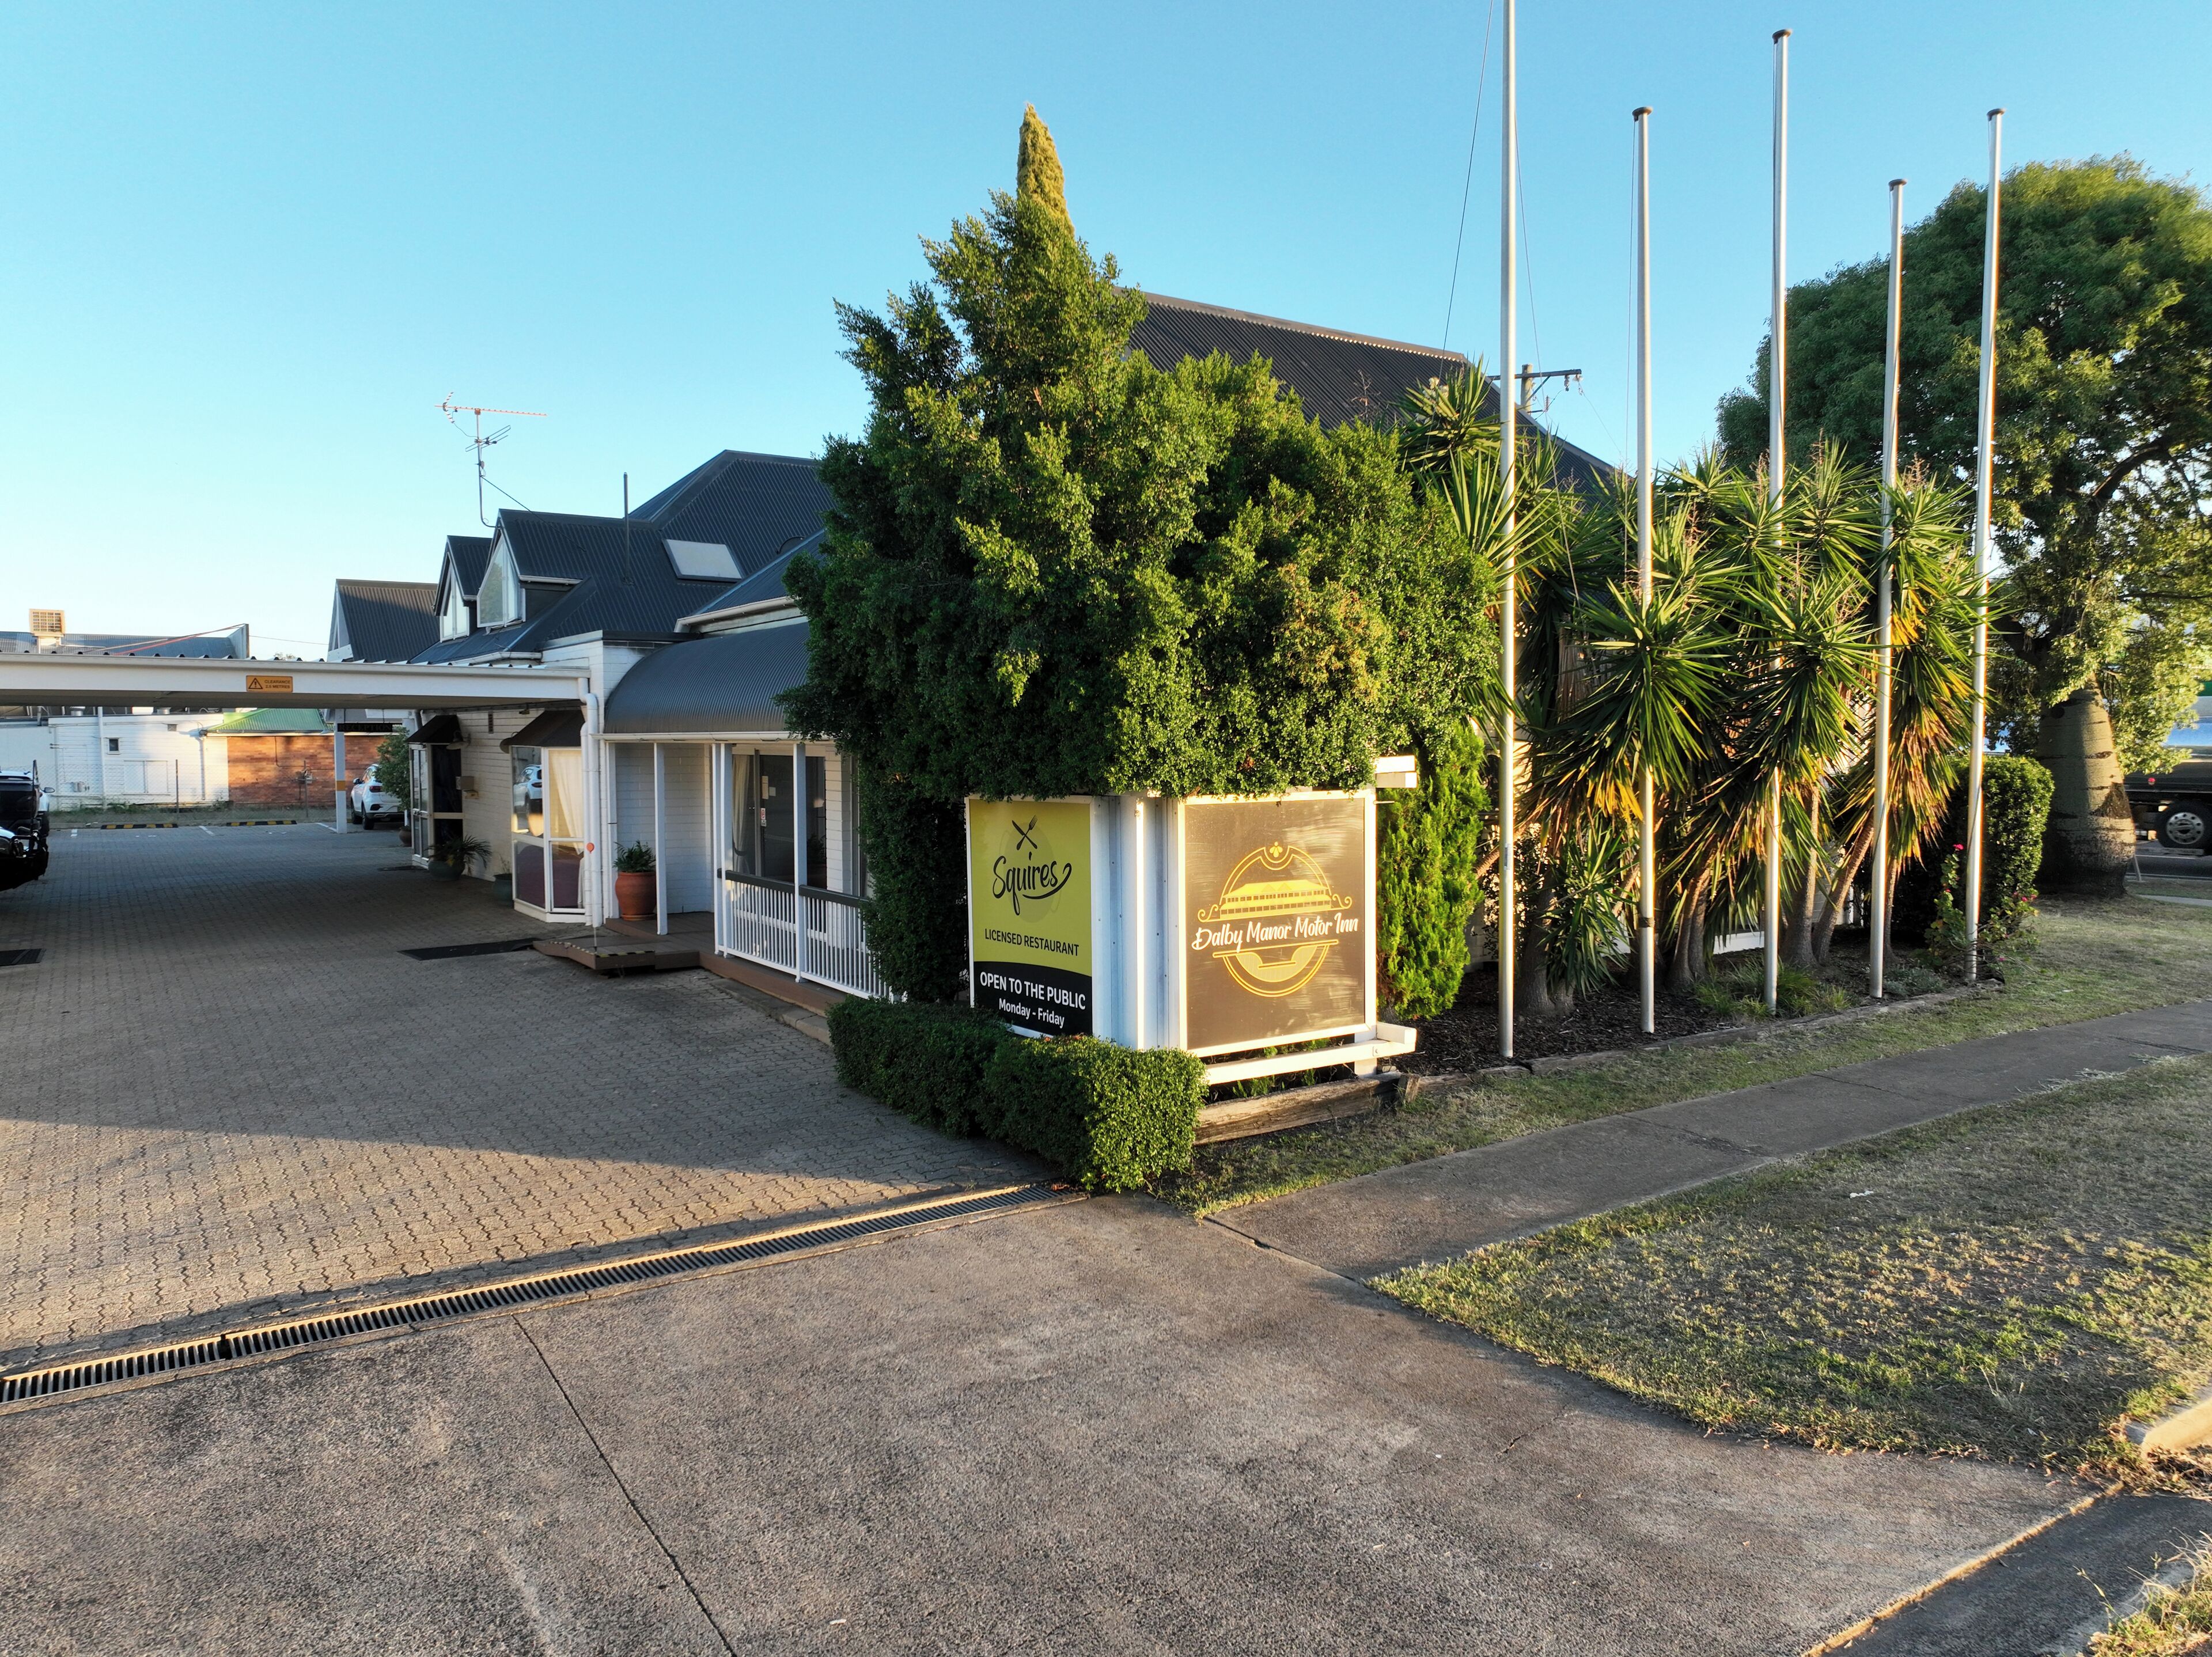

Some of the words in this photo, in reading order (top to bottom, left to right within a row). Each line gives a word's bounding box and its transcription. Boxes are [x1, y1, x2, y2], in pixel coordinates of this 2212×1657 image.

[993, 851, 1072, 916] Squires
[985, 928, 1022, 945] LICENSED
[1024, 935, 1079, 956] RESTAURANT
[1191, 923, 1243, 953] Dalby
[1246, 921, 1292, 943] Manor
[1294, 915, 1333, 938] Motor
[1334, 912, 1358, 934] Inn
[980, 972, 1006, 991] OPEN
[1009, 977, 1022, 994] TO
[1024, 981, 1045, 1000] THE
[1047, 986, 1086, 1010] PUBLIC
[999, 998, 1031, 1020] Monday
[1038, 1008, 1065, 1029] Friday
